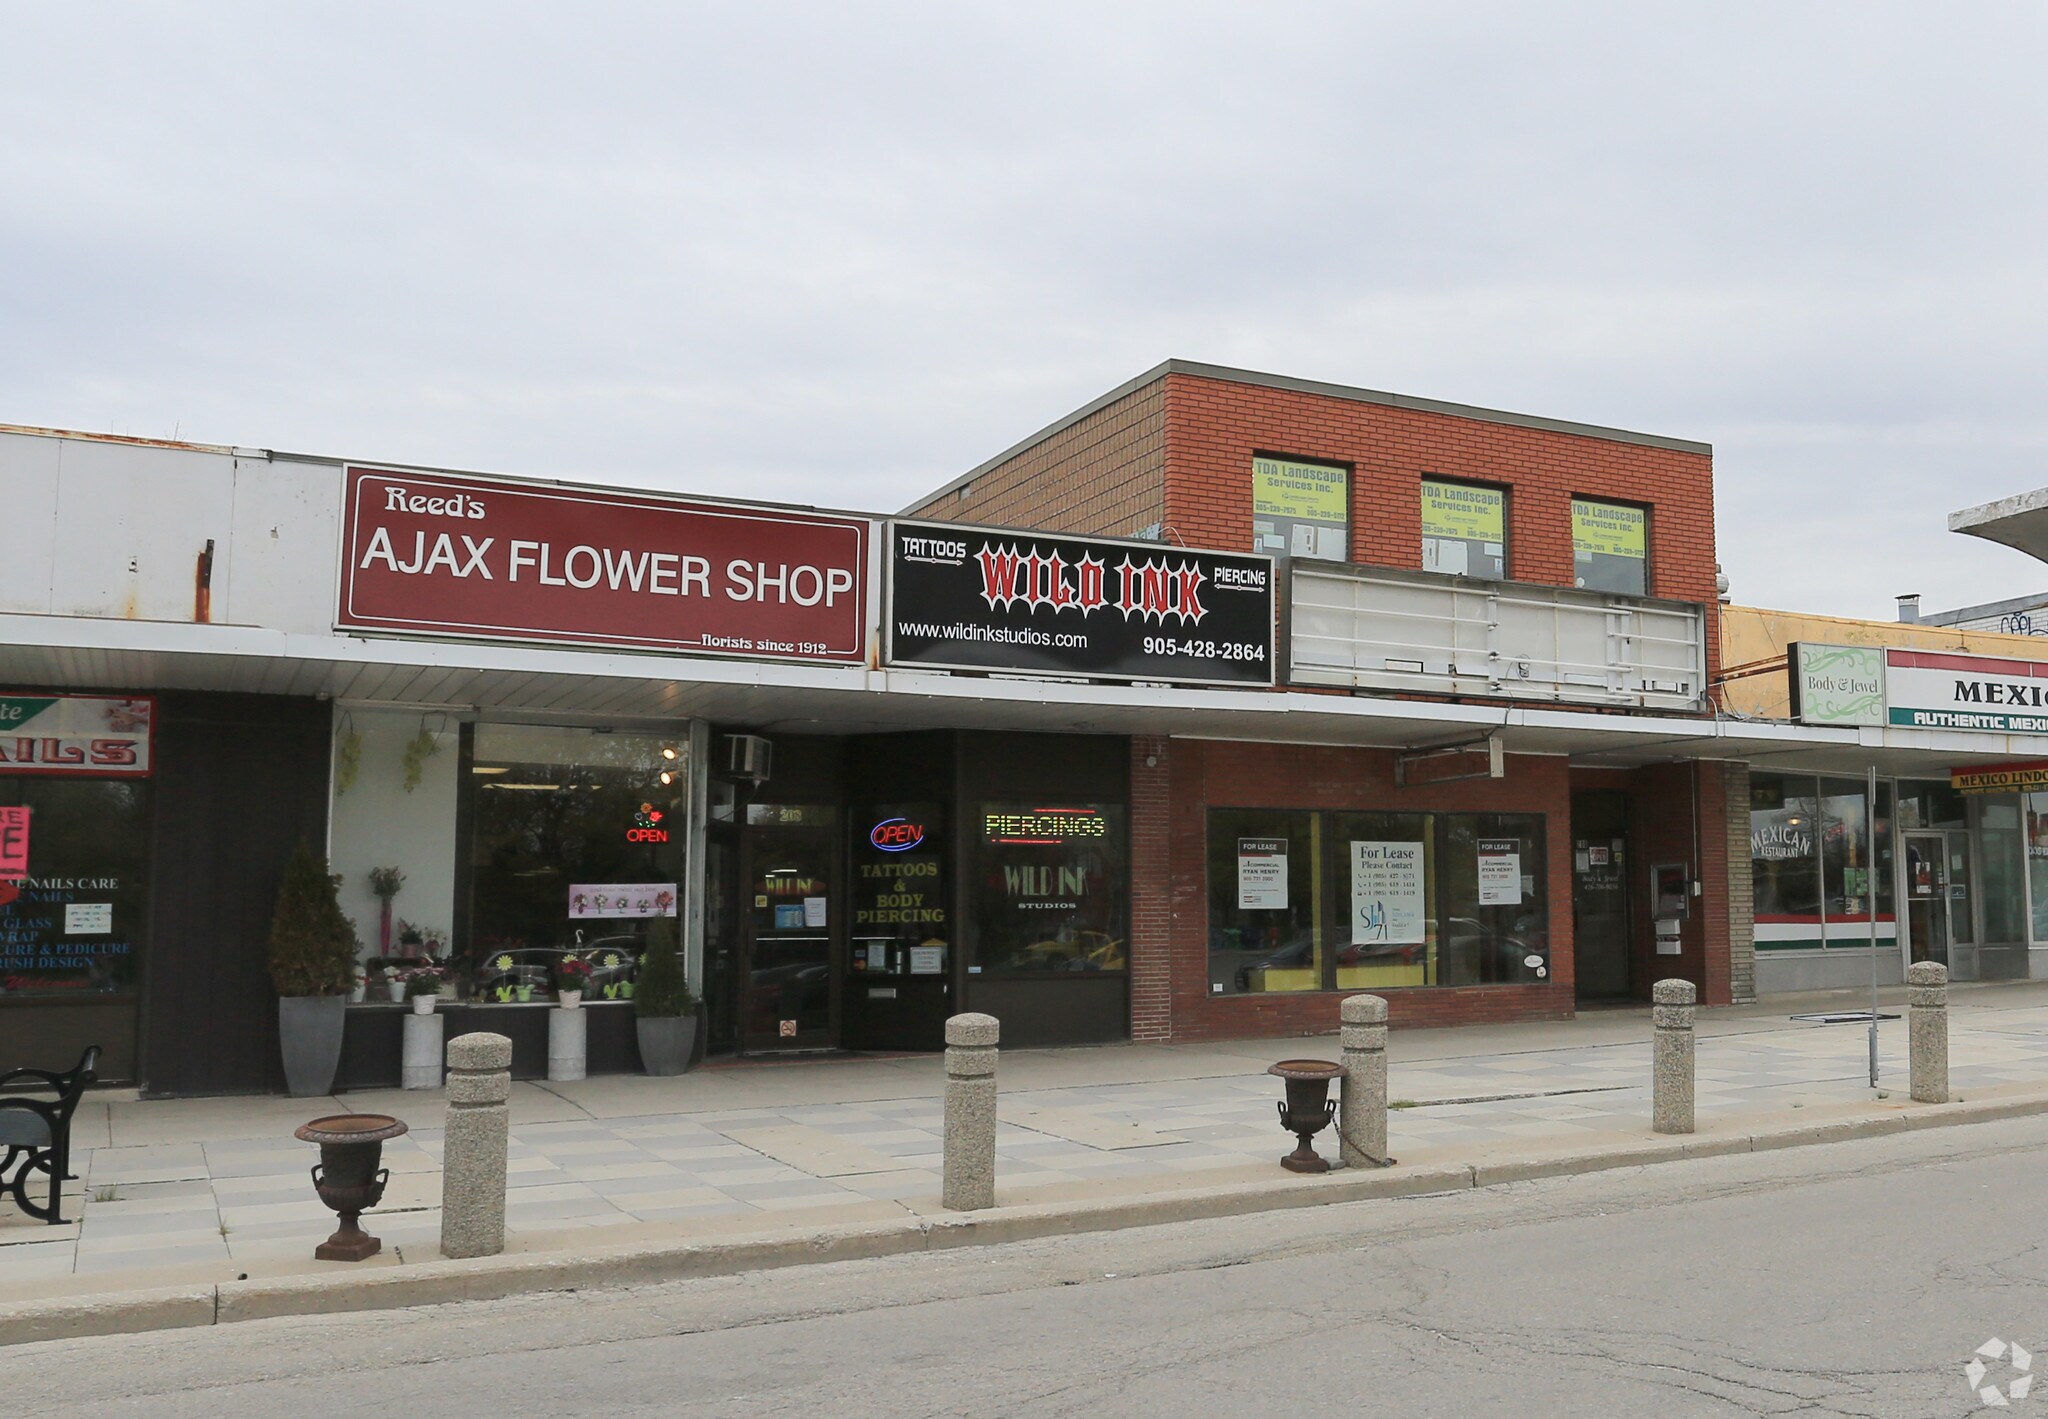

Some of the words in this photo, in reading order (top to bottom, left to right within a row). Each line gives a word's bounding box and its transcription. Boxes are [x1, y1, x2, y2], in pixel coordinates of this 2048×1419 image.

[1256, 462, 1278, 475] TDA
[1282, 465, 1344, 483] Landscape
[1267, 477, 1312, 490] Services
[384, 486, 486, 520] Reed's
[1422, 485, 1440, 498] TDA
[1445, 488, 1500, 505] Landscape
[1431, 500, 1472, 512] Services
[1572, 504, 1589, 516] TDA
[1593, 507, 1642, 523] Landscape
[1581, 518, 1617, 530] Services
[902, 536, 967, 559] TATTOOS
[361, 527, 495, 580] AJAX
[508, 540, 711, 598] FLOWER
[725, 559, 853, 608] SHOP
[1214, 566, 1266, 586] PIERCING
[973, 541, 1109, 619] WILD
[1113, 552, 1209, 627] INK
[702, 633, 753, 649] florists
[756, 639, 794, 652] since
[798, 642, 827, 655] 1912
[899, 621, 1088, 649] www.wildinkstudios.com
[1143, 637, 1264, 661] 905-428-2864
[1808, 676, 1835, 693] Body
[1838, 678, 1849, 691] &
[1849, 679, 1878, 694] Jewel
[1954, 680, 2048, 707] MEXI
[1914, 711, 2005, 729] AUTHENTIC
[2008, 717, 2048, 731] MEXI
[1960, 773, 2008, 787] MEXICO
[873, 825, 924, 843] OPEN
[986, 815, 1105, 837] PIERCINGS
[626, 829, 668, 842] OPEN
[1750, 826, 1811, 856] MEXICAN
[1360, 845, 1379, 859] For
[1383, 846, 1414, 859] Lease
[1761, 846, 1799, 858] RESTAURANT
[861, 862, 938, 878] TATTOOS
[1362, 861, 1384, 869] Please
[1386, 861, 1413, 869] Contact
[29, 878, 74, 889] NAILS
[78, 878, 119, 889] CARE
[893, 878, 906, 892] &
[1004, 865, 1053, 896] WILD
[876, 894, 924, 907] BODY
[856, 909, 945, 923] PIERCING
[56, 943, 130, 955] PEDICURE
[39, 956, 95, 968] DESIGN
